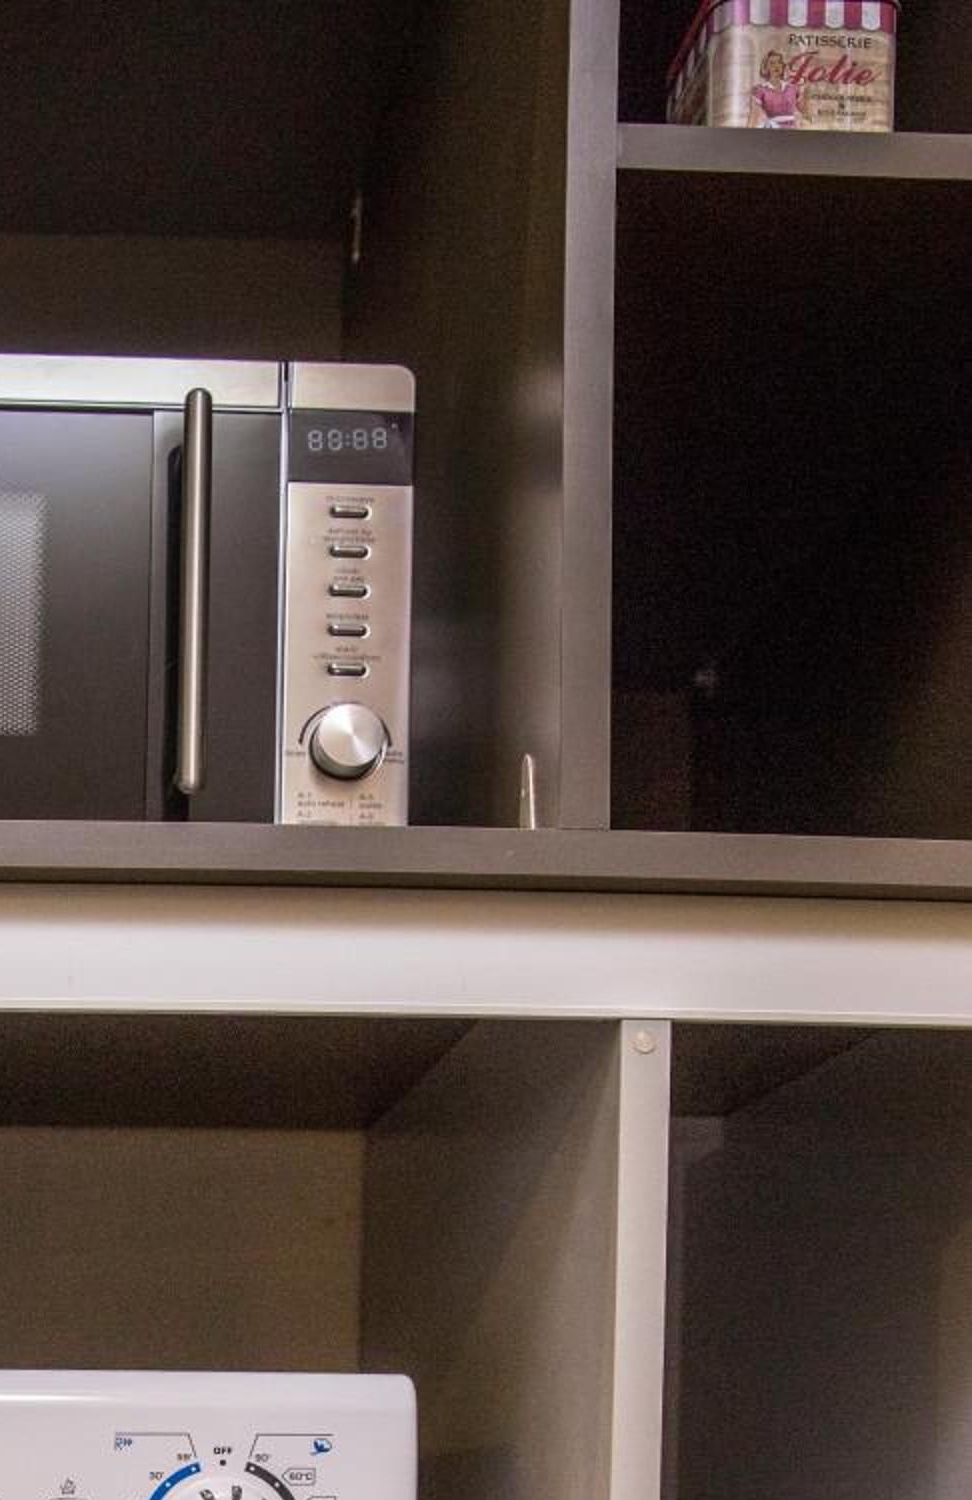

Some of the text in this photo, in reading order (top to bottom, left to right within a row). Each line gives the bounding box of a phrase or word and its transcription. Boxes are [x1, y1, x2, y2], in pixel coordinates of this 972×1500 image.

[788, 33, 872, 49] PATISSERIE
[789, 51, 881, 86] Jolie
[213, 1446, 232, 1455] OFF
